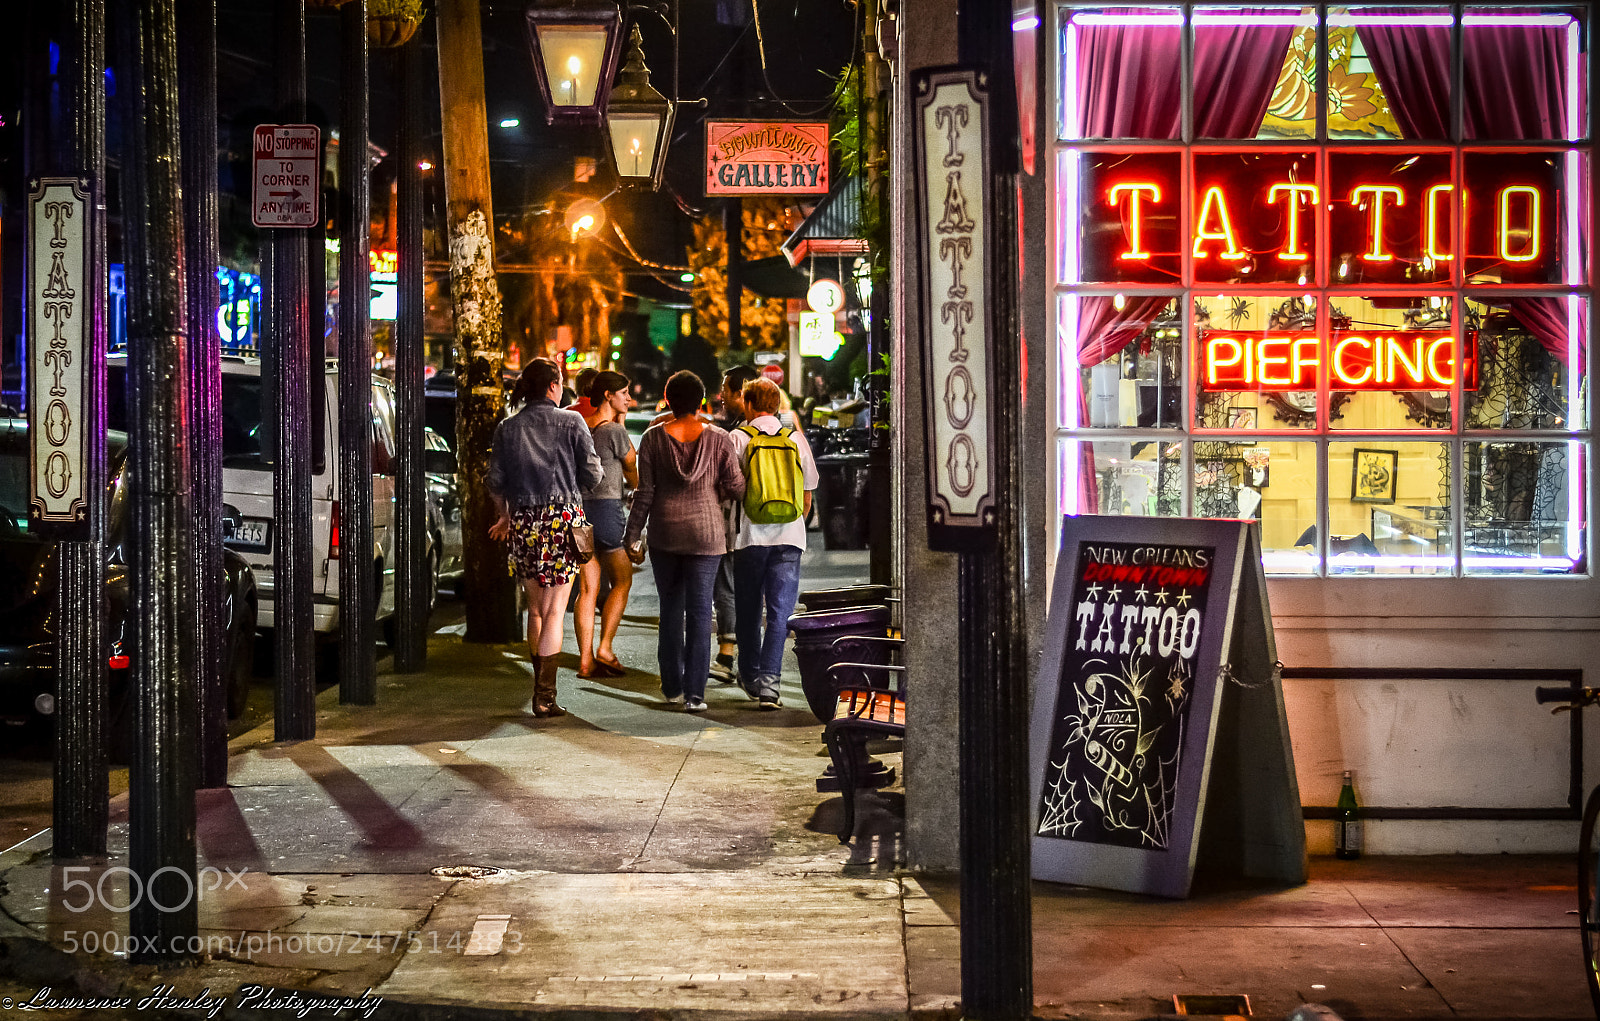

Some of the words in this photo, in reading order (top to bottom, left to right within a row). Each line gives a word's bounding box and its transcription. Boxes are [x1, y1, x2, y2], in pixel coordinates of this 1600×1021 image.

[256, 133, 273, 152] NO
[275, 137, 315, 150] STOPPING
[280, 161, 293, 173] TO
[718, 163, 820, 187] GALLERY
[262, 174, 310, 186] CORNER
[260, 201, 311, 214] ANYTIME
[1109, 182, 1540, 262] TATTOO
[935, 104, 979, 497] TATTOO
[42, 201, 76, 499] TATTOO
[1087, 546, 1127, 565] NEW
[1083, 562, 1208, 586] DOWNTOWN
[1075, 601, 1200, 660] TATTOO
[1103, 713, 1132, 724] NOLA
